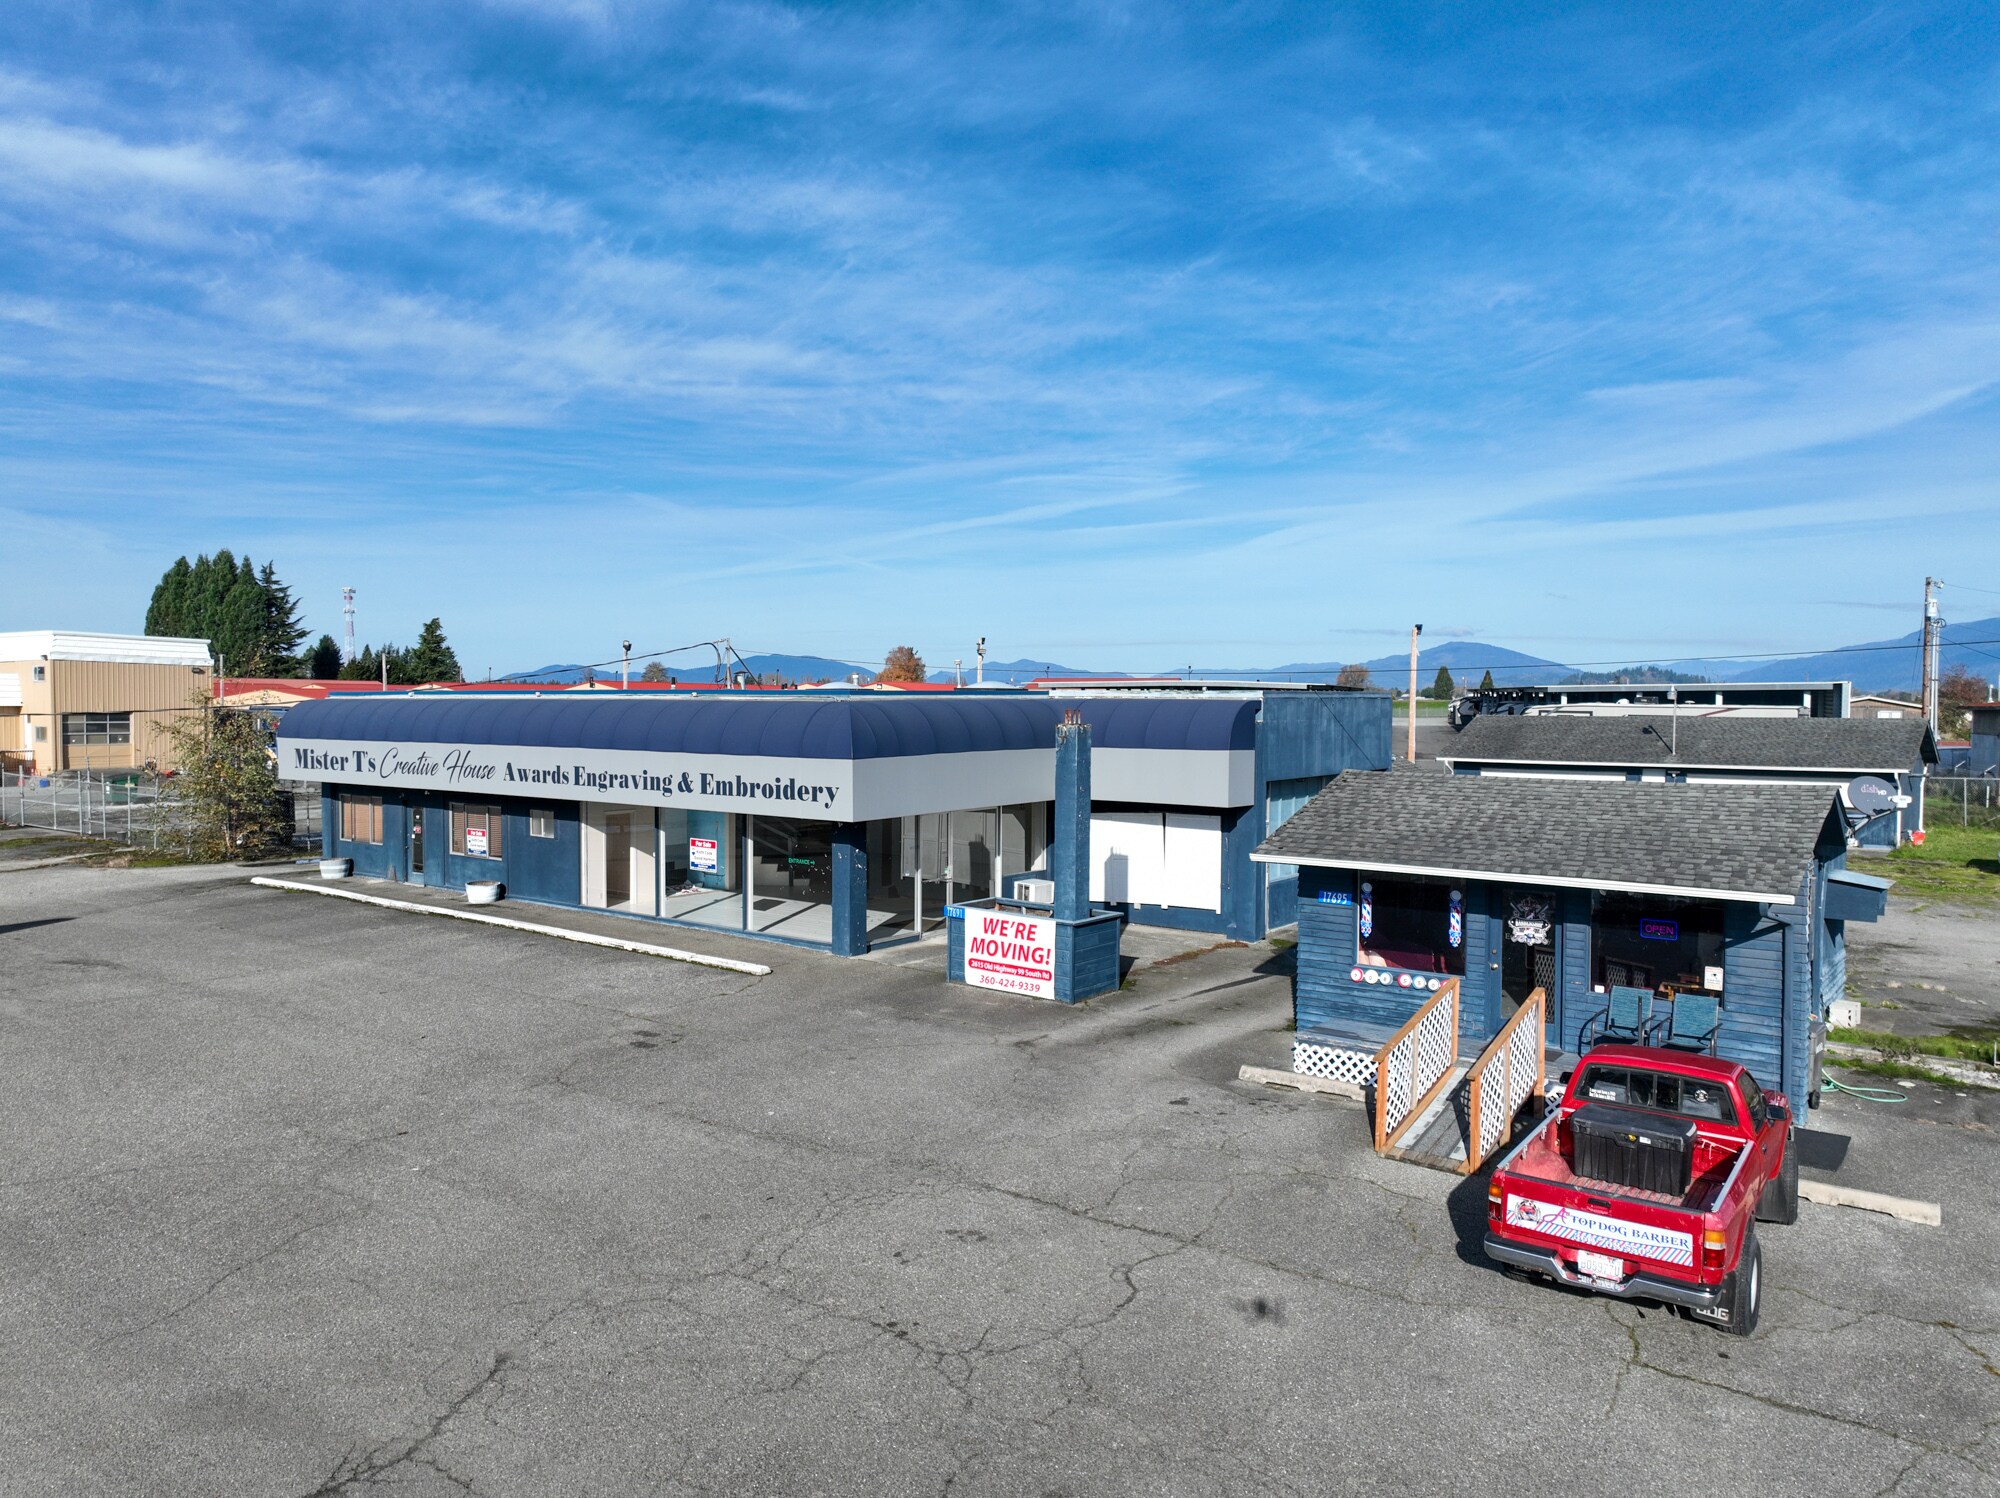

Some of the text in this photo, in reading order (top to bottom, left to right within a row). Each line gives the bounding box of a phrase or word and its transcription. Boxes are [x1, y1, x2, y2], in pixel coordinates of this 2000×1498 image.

[294, 747, 840, 809] Mister T's Creative House Awards Engraving & Embroidery
[1861, 784, 1878, 794] dish
[1322, 891, 1348, 905] 17695
[947, 906, 963, 918] 17691
[983, 917, 1037, 941] WE'RE
[1645, 924, 1674, 935] OPEN
[970, 937, 1051, 965] MOVING!
[971, 960, 983, 968] 2615
[984, 962, 993, 970] Old
[993, 964, 1017, 975] Highway
[1025, 969, 1041, 978] South
[1042, 971, 1050, 979] Rd
[979, 975, 1040, 992] 360-424-9339
[1571, 1215, 1597, 1229] TOP
[1599, 1222, 1627, 1237] DOG
[1632, 1229, 1690, 1250] BARBER
